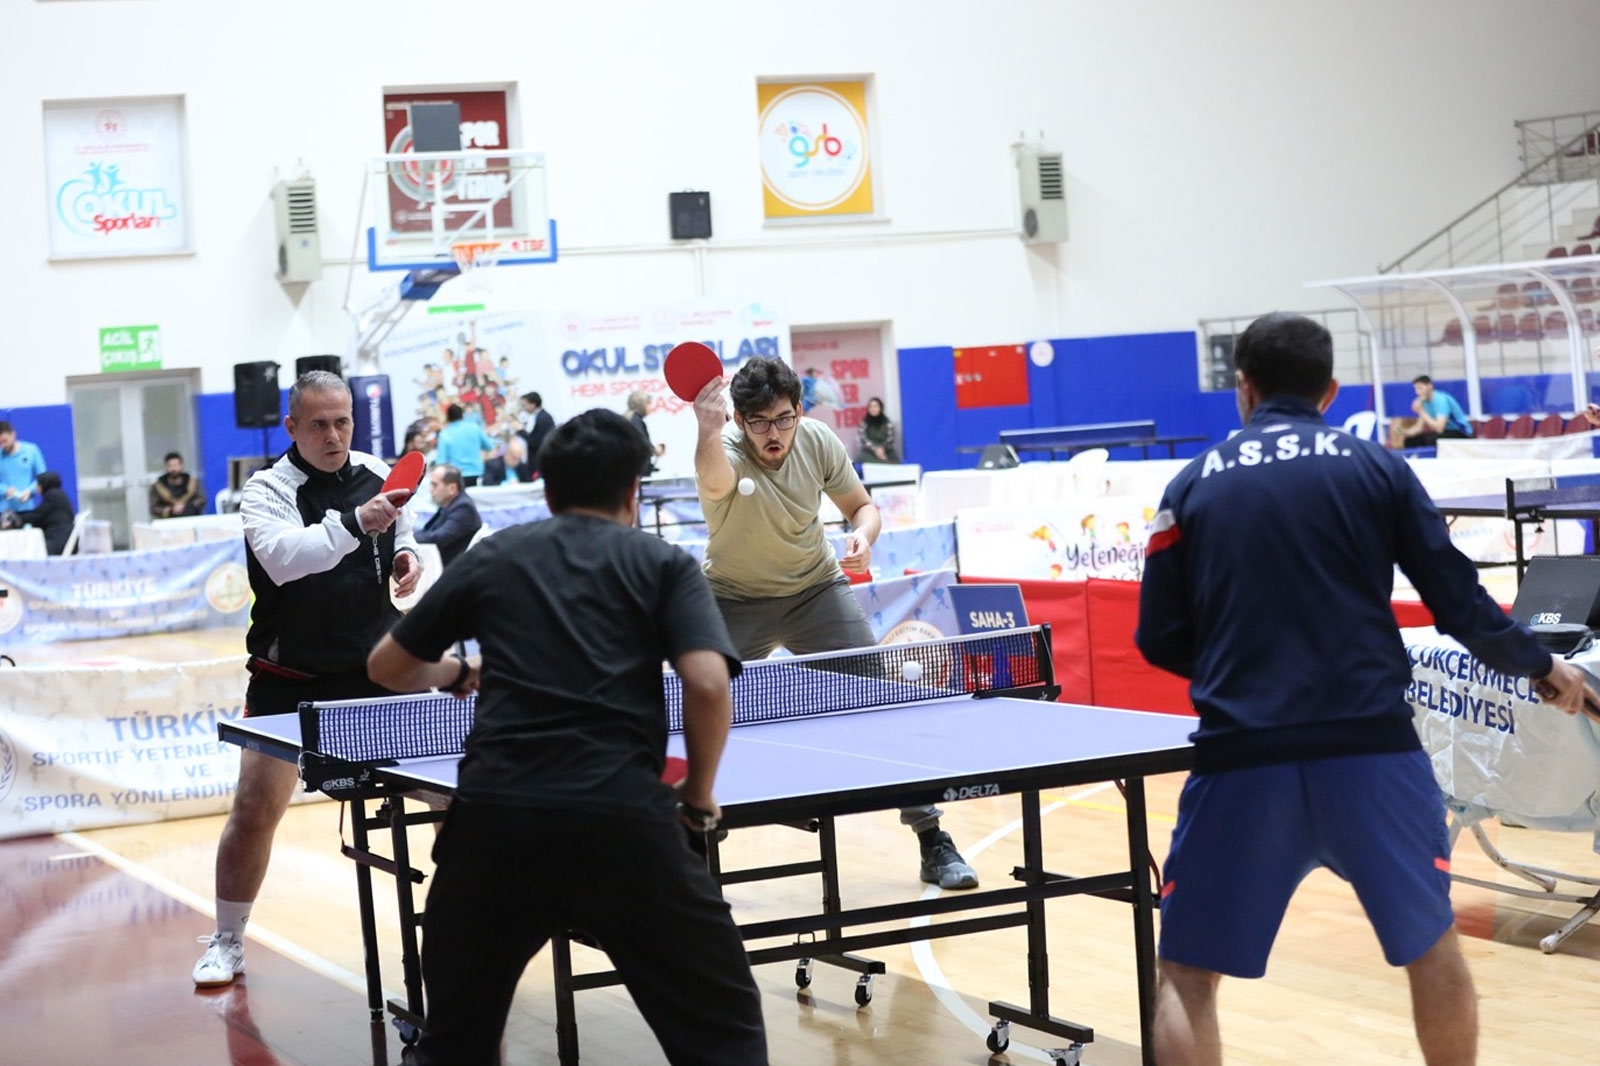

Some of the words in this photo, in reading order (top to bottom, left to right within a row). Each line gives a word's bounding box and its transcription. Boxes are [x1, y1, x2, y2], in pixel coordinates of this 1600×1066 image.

[561, 346, 640, 377] OKUL
[842, 384, 858, 402] ER
[1201, 431, 1352, 478] A.S.S.K.
[969, 611, 1015, 629] SAHA-3
[1538, 612, 1562, 624] KBS
[1407, 677, 1515, 735] BELEDİYESİ
[106, 703, 241, 742] TÜRKİY
[33, 750, 124, 768] SPORTİF
[131, 741, 231, 763] YETENEK
[184, 763, 211, 778] VE
[331, 777, 355, 788] KBS
[958, 783, 1000, 800] DELTA
[24, 792, 101, 812] SPORA
